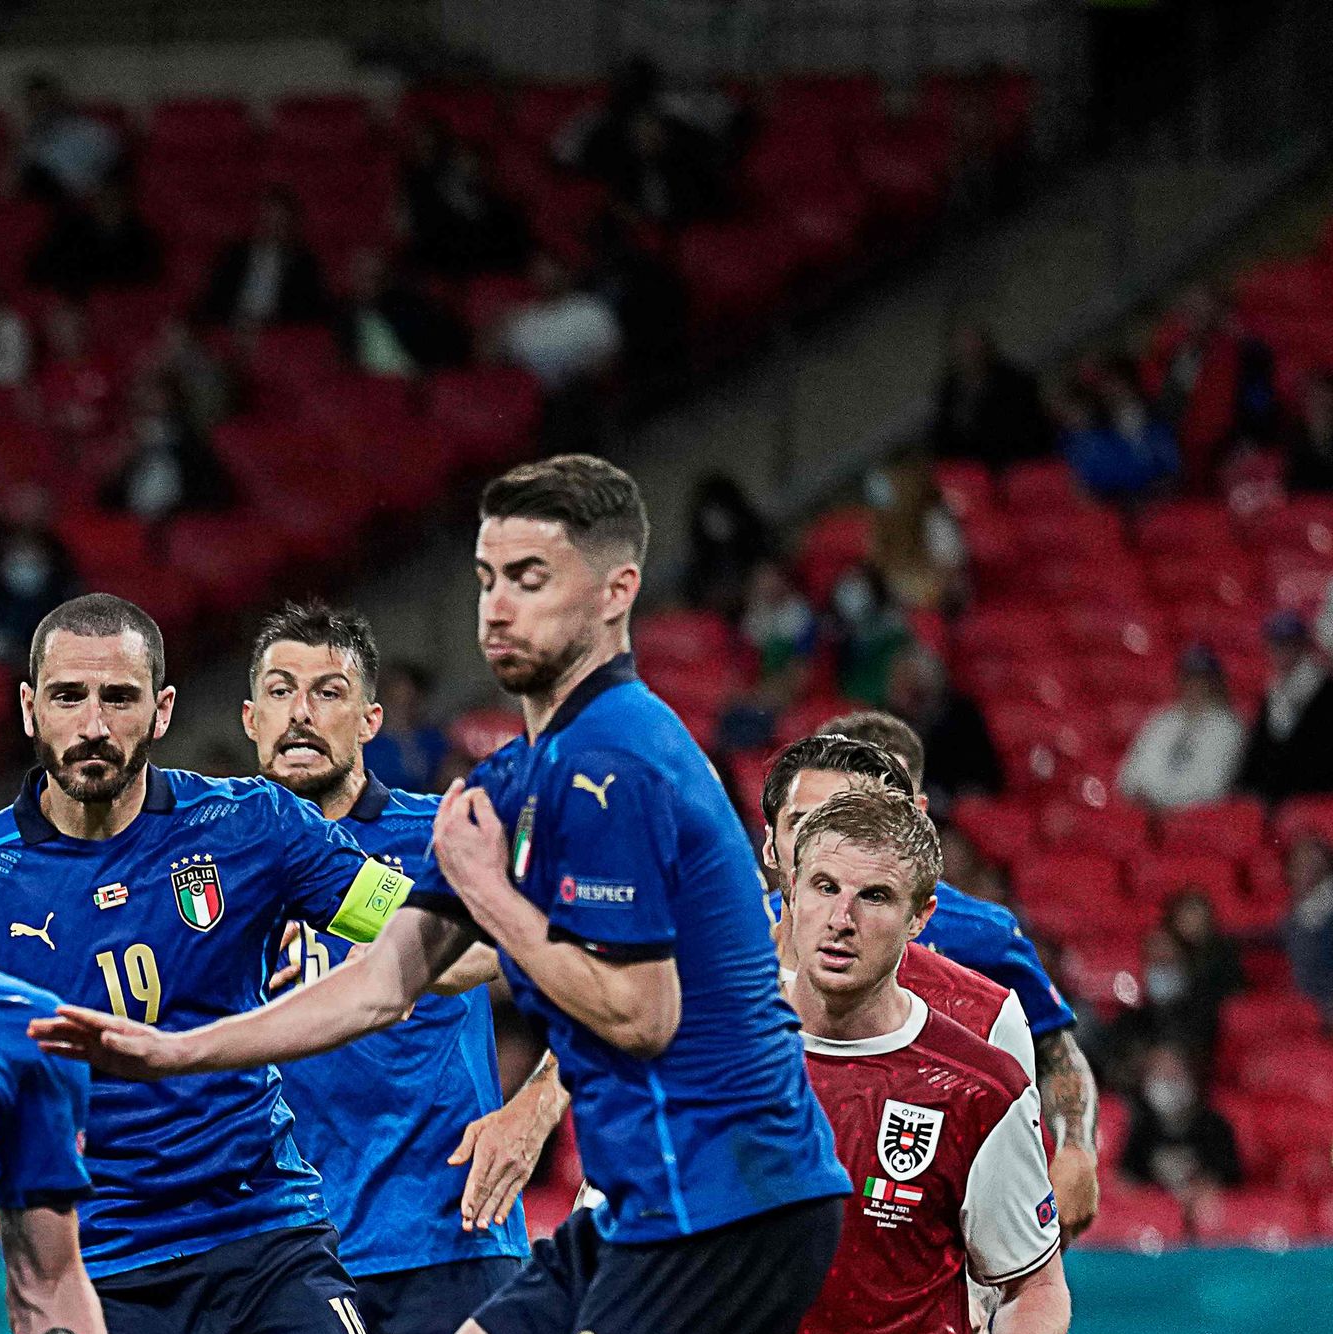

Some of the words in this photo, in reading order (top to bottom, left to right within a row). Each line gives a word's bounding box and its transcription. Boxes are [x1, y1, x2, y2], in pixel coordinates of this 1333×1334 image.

[176, 869, 214, 886] ITALIA
[96, 943, 162, 1025] 19
[901, 1108, 926, 1120] ÖFB
